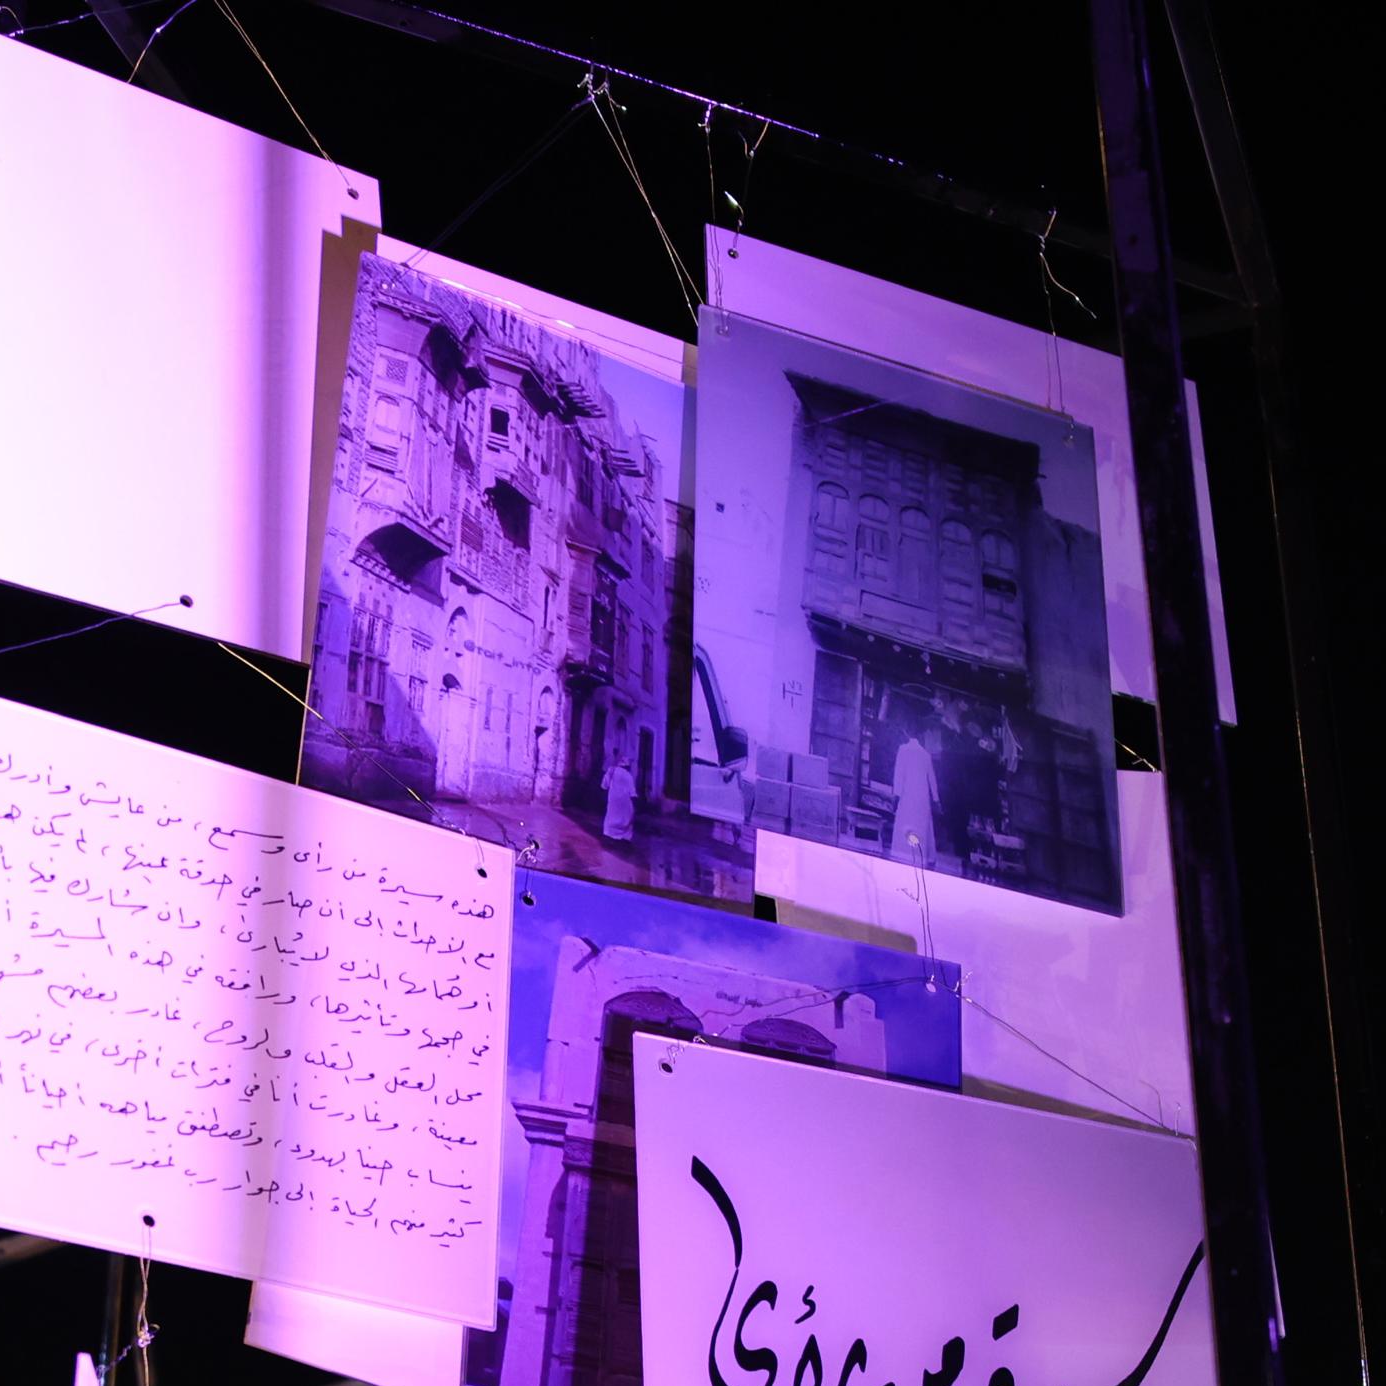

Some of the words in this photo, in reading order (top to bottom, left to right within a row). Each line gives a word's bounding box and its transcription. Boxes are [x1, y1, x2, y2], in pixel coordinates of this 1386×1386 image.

[77, 779, 145, 819] عايش
[155, 803, 183, 828] من
[30, 810, 73, 849] يكن
[73, 826, 87, 855] لم
[192, 820, 286, 855] وسمع،
[292, 840, 333, 873] رأى
[341, 857, 367, 881] من
[27, 855, 57, 894] فيها
[177, 855, 234, 901] حدقة
[235, 874, 262, 907] في
[376, 865, 445, 907] سيرة
[260, 889, 314, 919] صار
[450, 897, 495, 921] هذه
[352, 908, 384, 937] إلى
[127, 939, 174, 975] هذه
[180, 952, 205, 985] في
[298, 944, 330, 962] لا
[472, 951, 496, 971] مع
[213, 967, 297, 1006] ورافقه
[336, 957, 389, 991] الذي
[45, 971, 118, 1015] بعضهم
[123, 995, 182, 1022] غادر
[3, 1012, 42, 1046] نهر
[47, 1020, 74, 1055] في
[191, 1018, 292, 1060] والروح،
[416, 1026, 464, 1059] حجمها
[83, 1037, 163, 1075] أخرى،
[302, 1041, 376, 1085] والقلب
[466, 1033, 491, 1067] في
[169, 1058, 232, 1090] فترات
[236, 1071, 261, 1103] في
[268, 1073, 299, 1107] أنا
[382, 1065, 438, 1106] العقل
[307, 1093, 400, 1132] وغادرت
[444, 1086, 483, 1106] محل
[97, 1098, 168, 1135] مياهه
[410, 1117, 478, 1152] معينة،
[108, 1142, 176, 1171] غفور
[182, 1167, 218, 1187] رب
[220, 1168, 281, 1206] جوار
[405, 1167, 473, 1205] ينساب
[284, 1181, 315, 1212] إلى
[328, 1195, 379, 1229] الحياة
[388, 1208, 426, 1236] منهم
[427, 1216, 483, 1249] كثير
